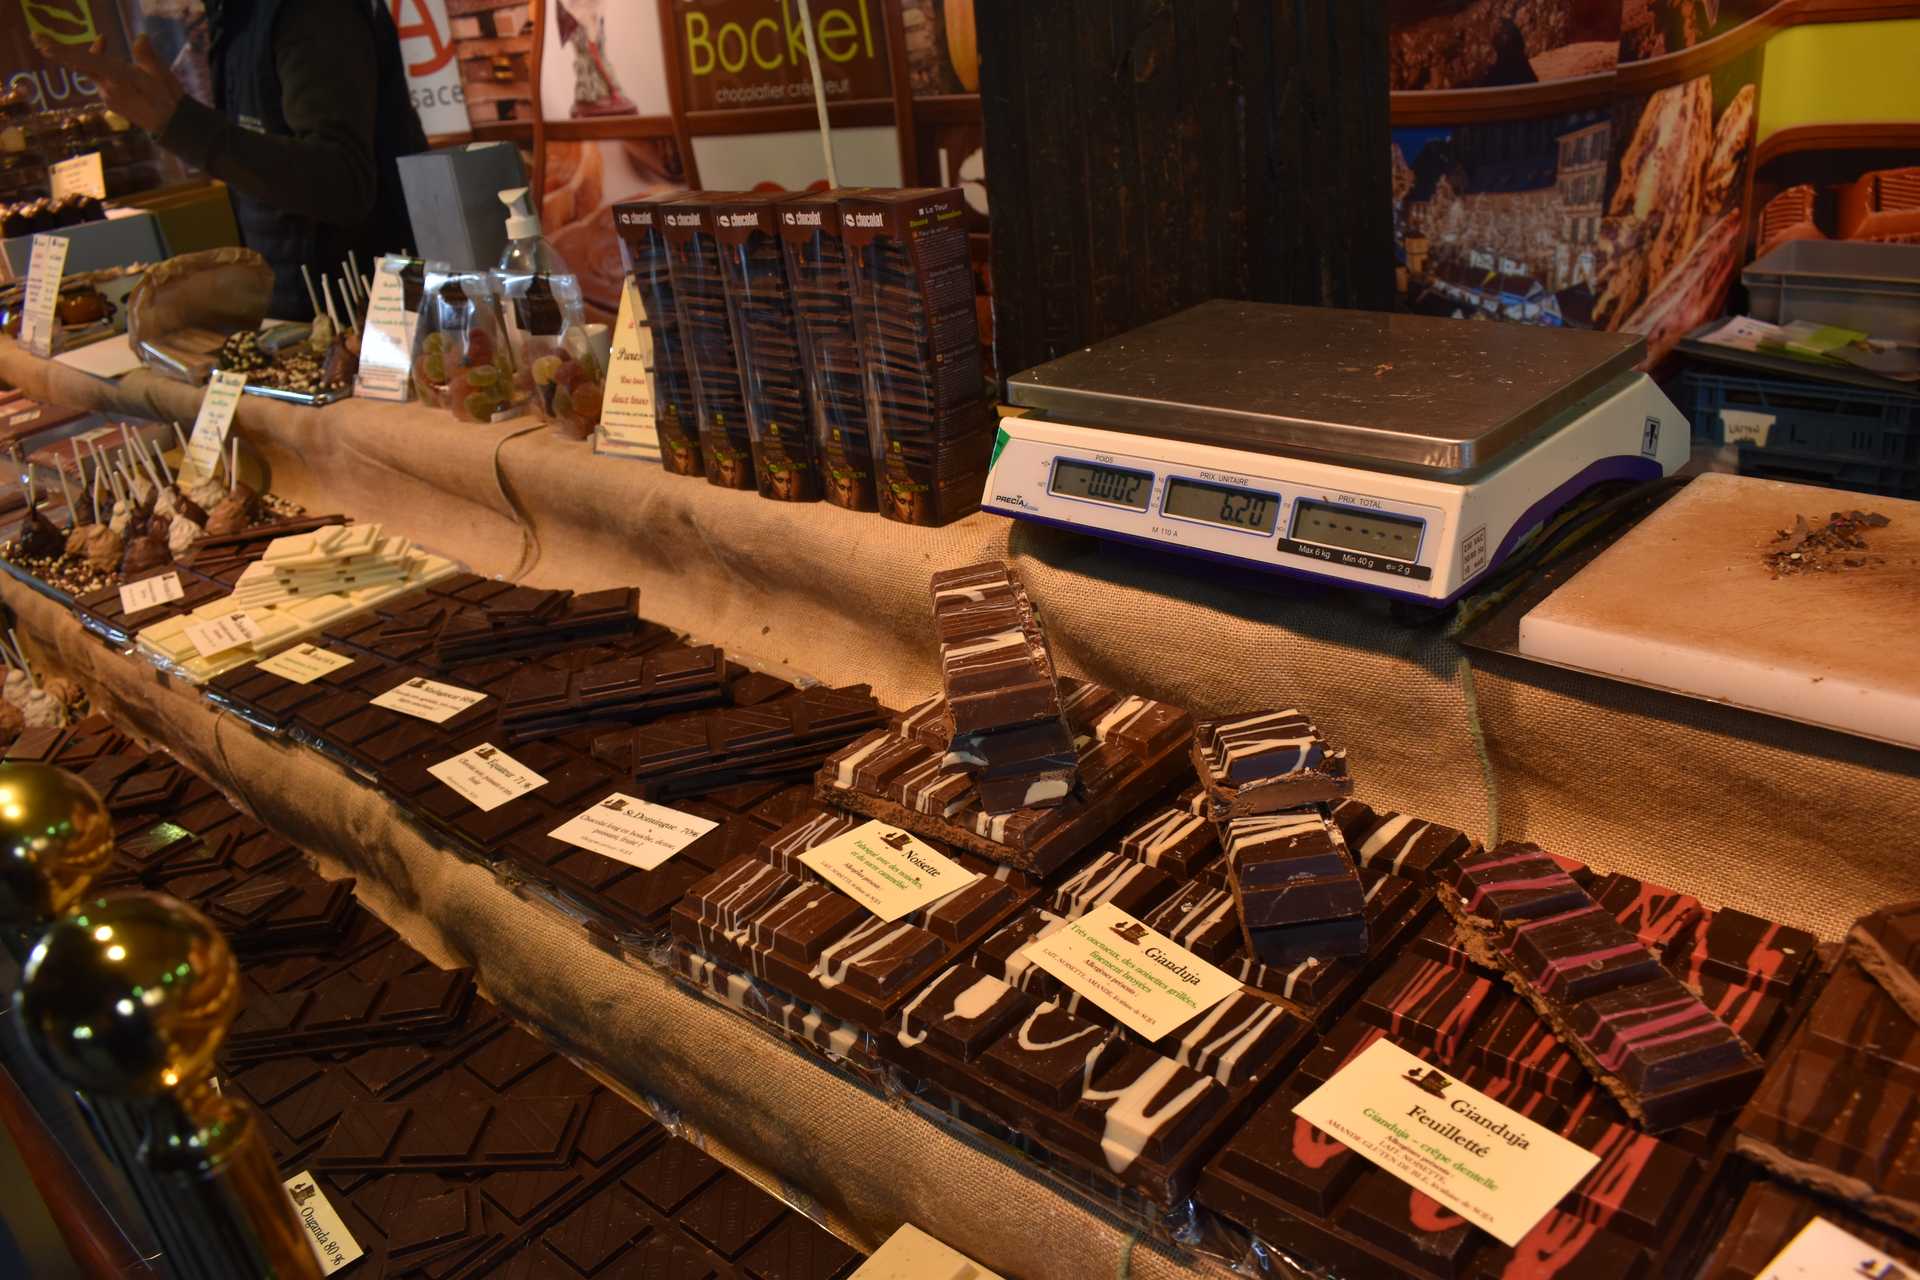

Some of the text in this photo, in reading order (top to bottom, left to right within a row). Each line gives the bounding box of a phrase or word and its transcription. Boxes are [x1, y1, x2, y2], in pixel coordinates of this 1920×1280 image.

[686, 0, 875, 75] Bockel
[715, 83, 785, 103] chocolatier
[856, 212, 883, 227] chocolat
[1095, 454, 1114, 463] POIDS
[1200, 471, 1249, 486] PRIX UNITAIRE
[1338, 494, 1383, 509] PRIX TOTAL
[1298, 545, 1314, 555] Max
[1314, 548, 1321, 556] 6
[1321, 550, 1332, 559] kg
[1342, 554, 1356, 563] Min
[1357, 556, 1368, 566] 40
[1367, 560, 1374, 568] g
[1404, 567, 1411, 575] g
[901, 850, 940, 877] Noisette
[1121, 958, 1135, 969] des
[1135, 967, 1168, 989] noisettes
[1145, 947, 1200, 986] Gianduja
[1406, 1105, 1490, 1157] Feuilletté
[1450, 1099, 1530, 1150] Gianduja
[1363, 1108, 1410, 1140] Gianduja
[1420, 1144, 1452, 1163] crêpe
[1452, 1163, 1498, 1190] dentelle
[301, 1207, 346, 1266] Ouganda 80 %
